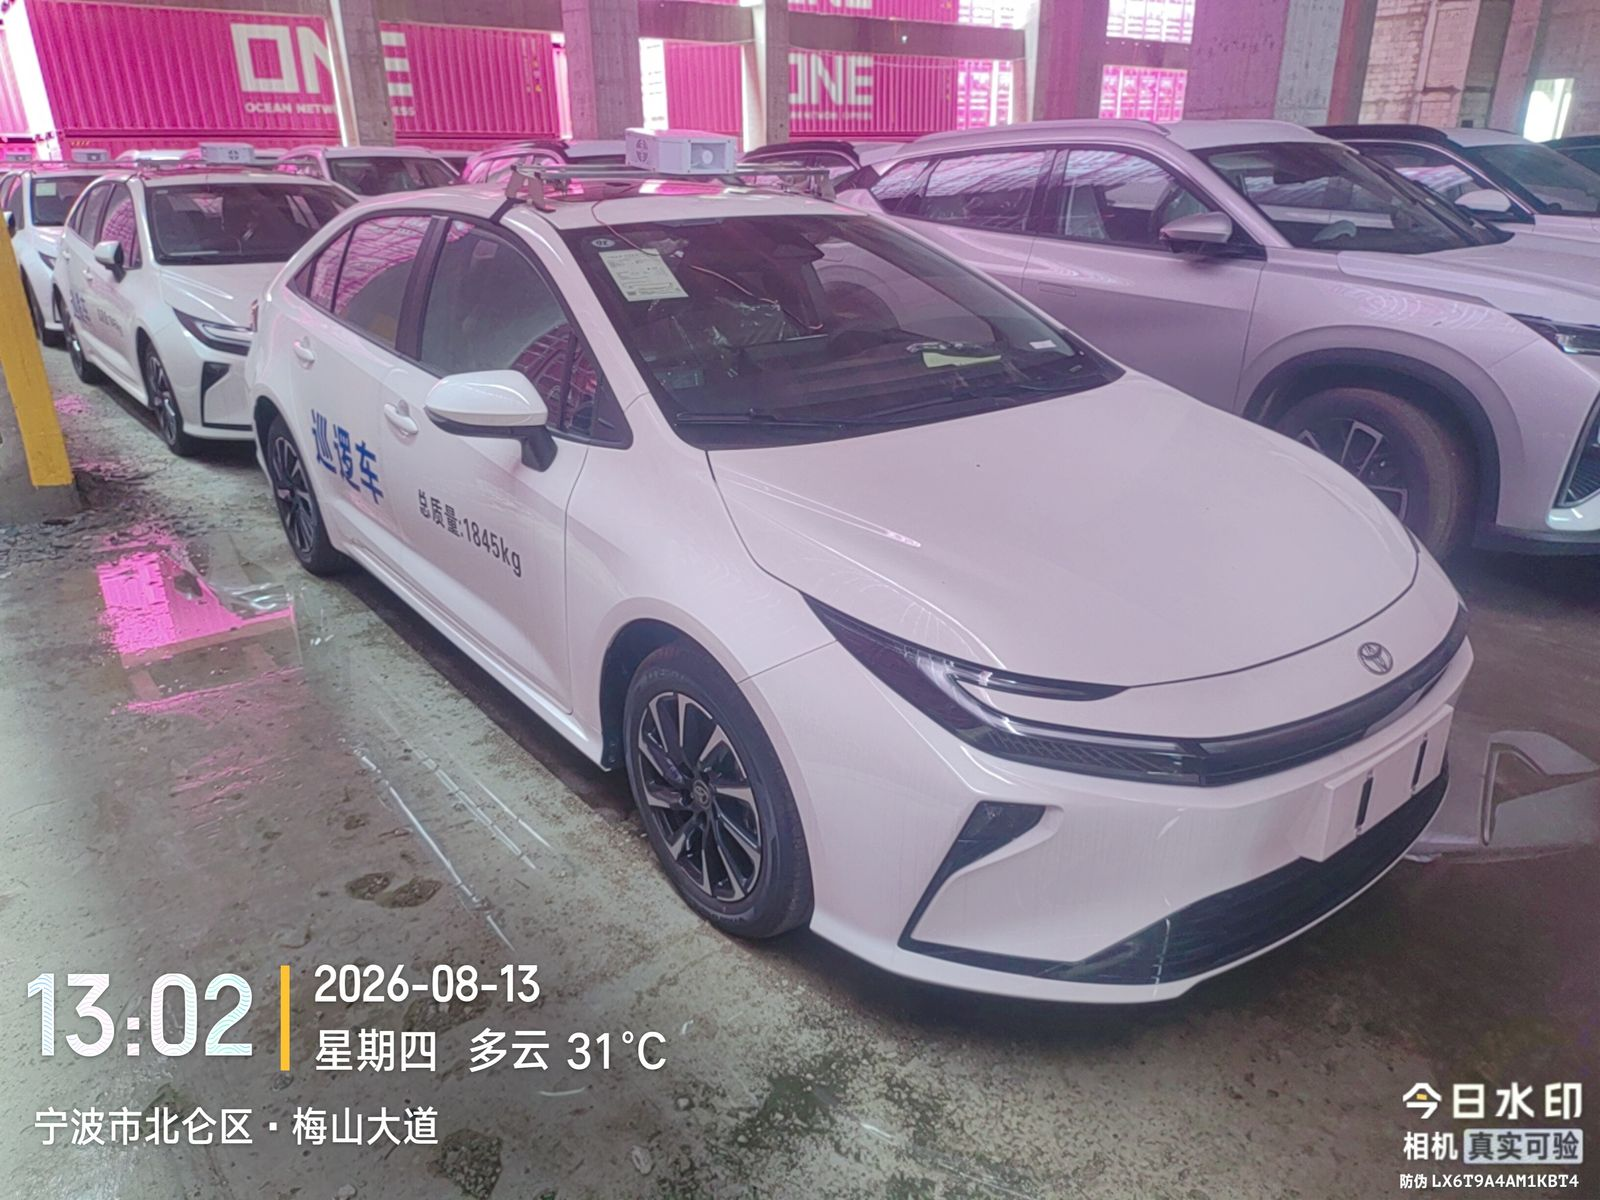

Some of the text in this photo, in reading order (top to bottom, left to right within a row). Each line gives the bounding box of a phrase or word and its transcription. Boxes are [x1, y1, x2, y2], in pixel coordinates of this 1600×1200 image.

[244, 102, 292, 114] OCEAN
[311, 409, 384, 505] 巡逻车
